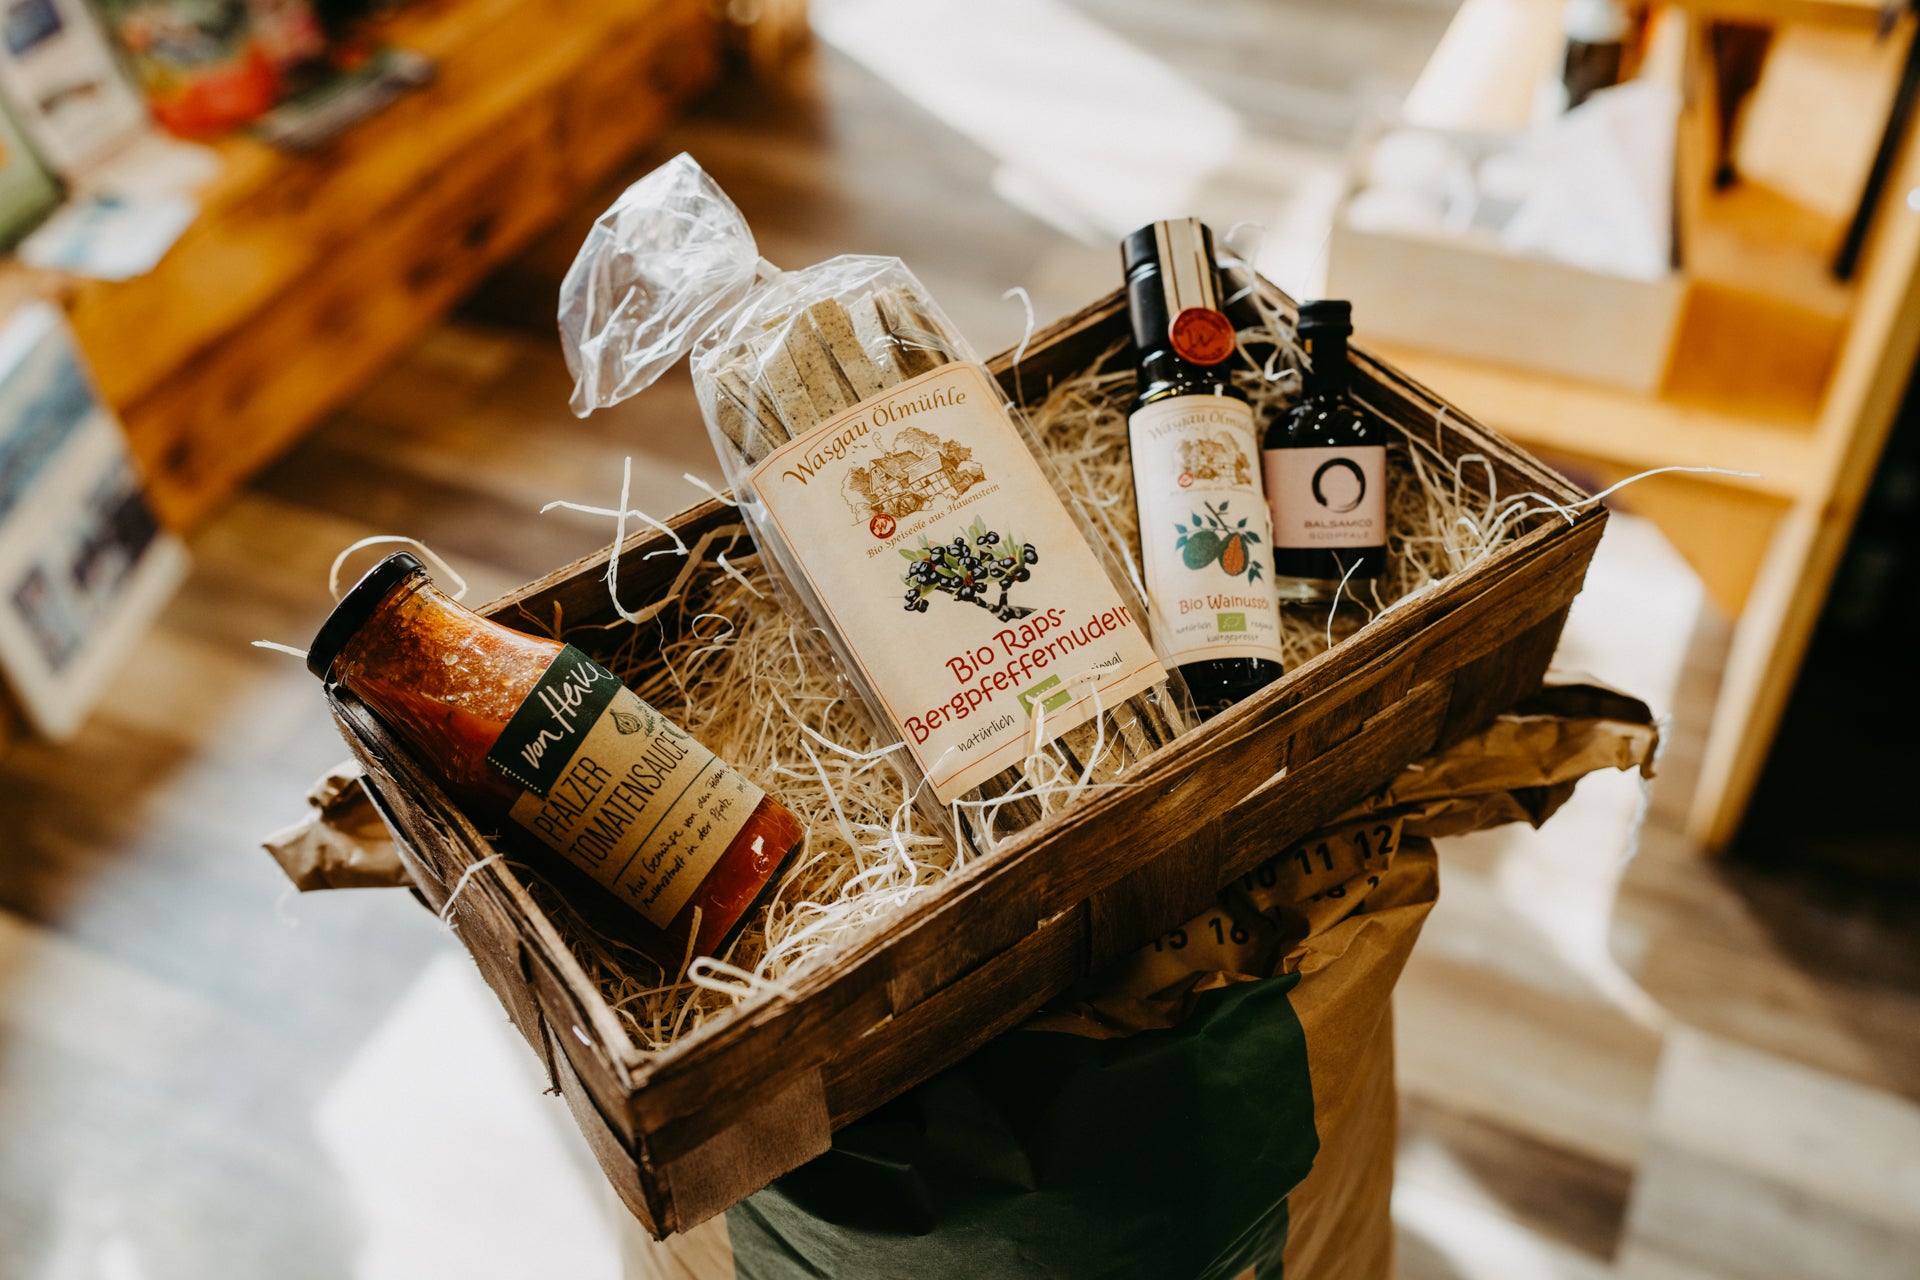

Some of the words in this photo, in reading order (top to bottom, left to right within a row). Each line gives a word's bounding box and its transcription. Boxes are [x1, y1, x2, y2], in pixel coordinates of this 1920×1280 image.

[782, 415, 870, 485] Wasgau
[872, 386, 967, 428] Ölmühle
[866, 543, 883, 559] Bio
[885, 520, 927, 549] Speiseöle
[929, 512, 945, 524] aus
[947, 483, 1000, 514] Hauenstein
[1304, 518, 1373, 528] BALSAMICO
[1179, 599, 1203, 615] Bio
[945, 646, 995, 684] Bio
[992, 607, 1066, 656] Raps-
[538, 661, 614, 734] Heike
[520, 729, 564, 770] von
[958, 713, 1015, 752] natürlich
[569, 731, 688, 868] TOMATENSAUCE
[642, 830, 684, 874] Gemüse
[684, 813, 698, 828] von
[698, 793, 712, 809] den
[685, 846, 698, 856] in
[698, 822, 712, 841] der
[1295, 843, 1333, 874] 11
[1355, 825, 1393, 859] 12
[1209, 918, 1248, 945] 16
